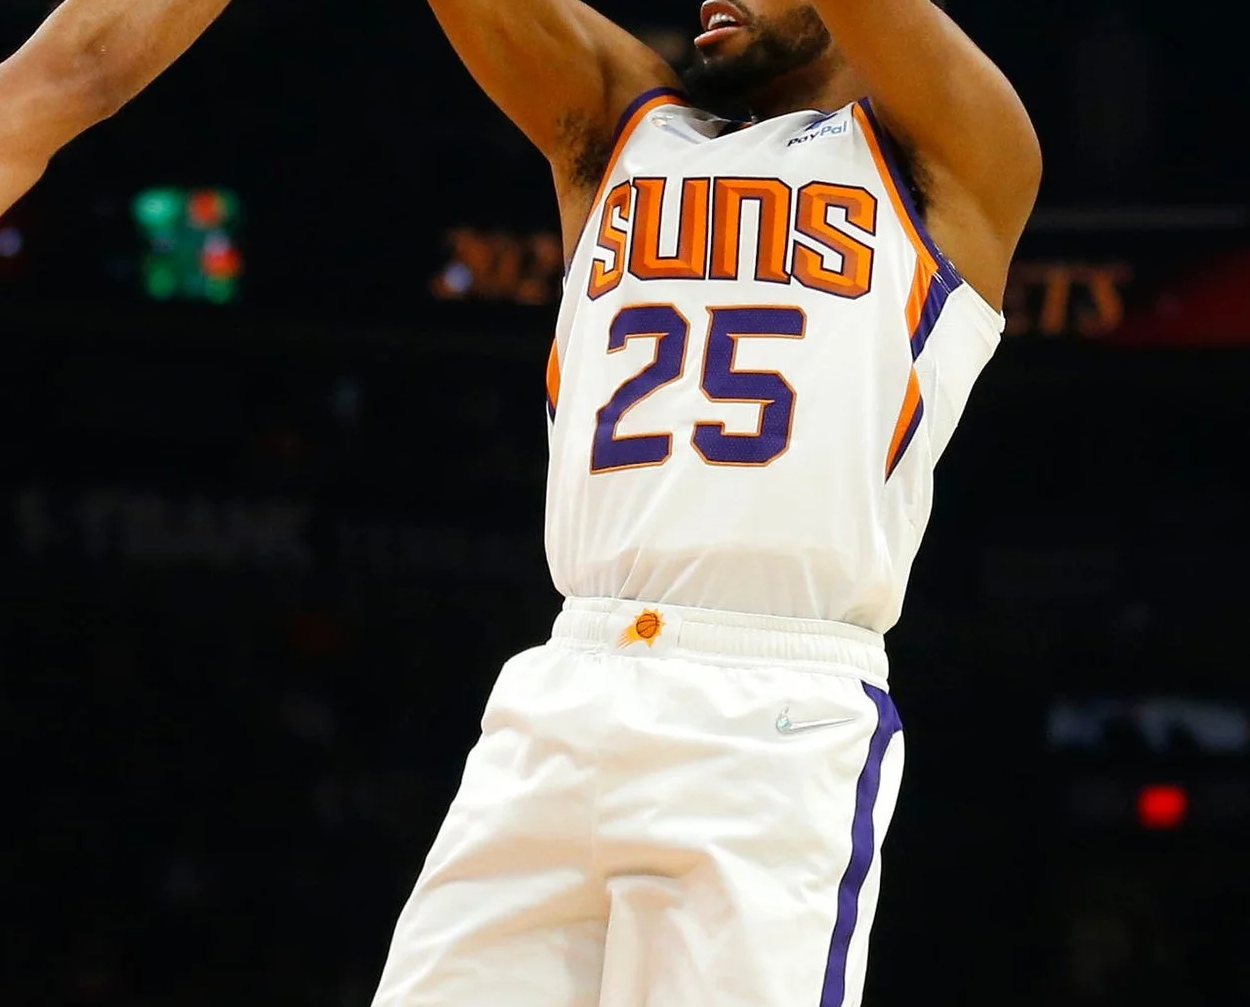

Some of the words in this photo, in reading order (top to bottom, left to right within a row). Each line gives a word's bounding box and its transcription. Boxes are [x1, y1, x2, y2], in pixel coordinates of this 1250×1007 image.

[787, 120, 847, 148] PayPal
[587, 176, 878, 301] SUNS
[590, 302, 807, 475] 25
